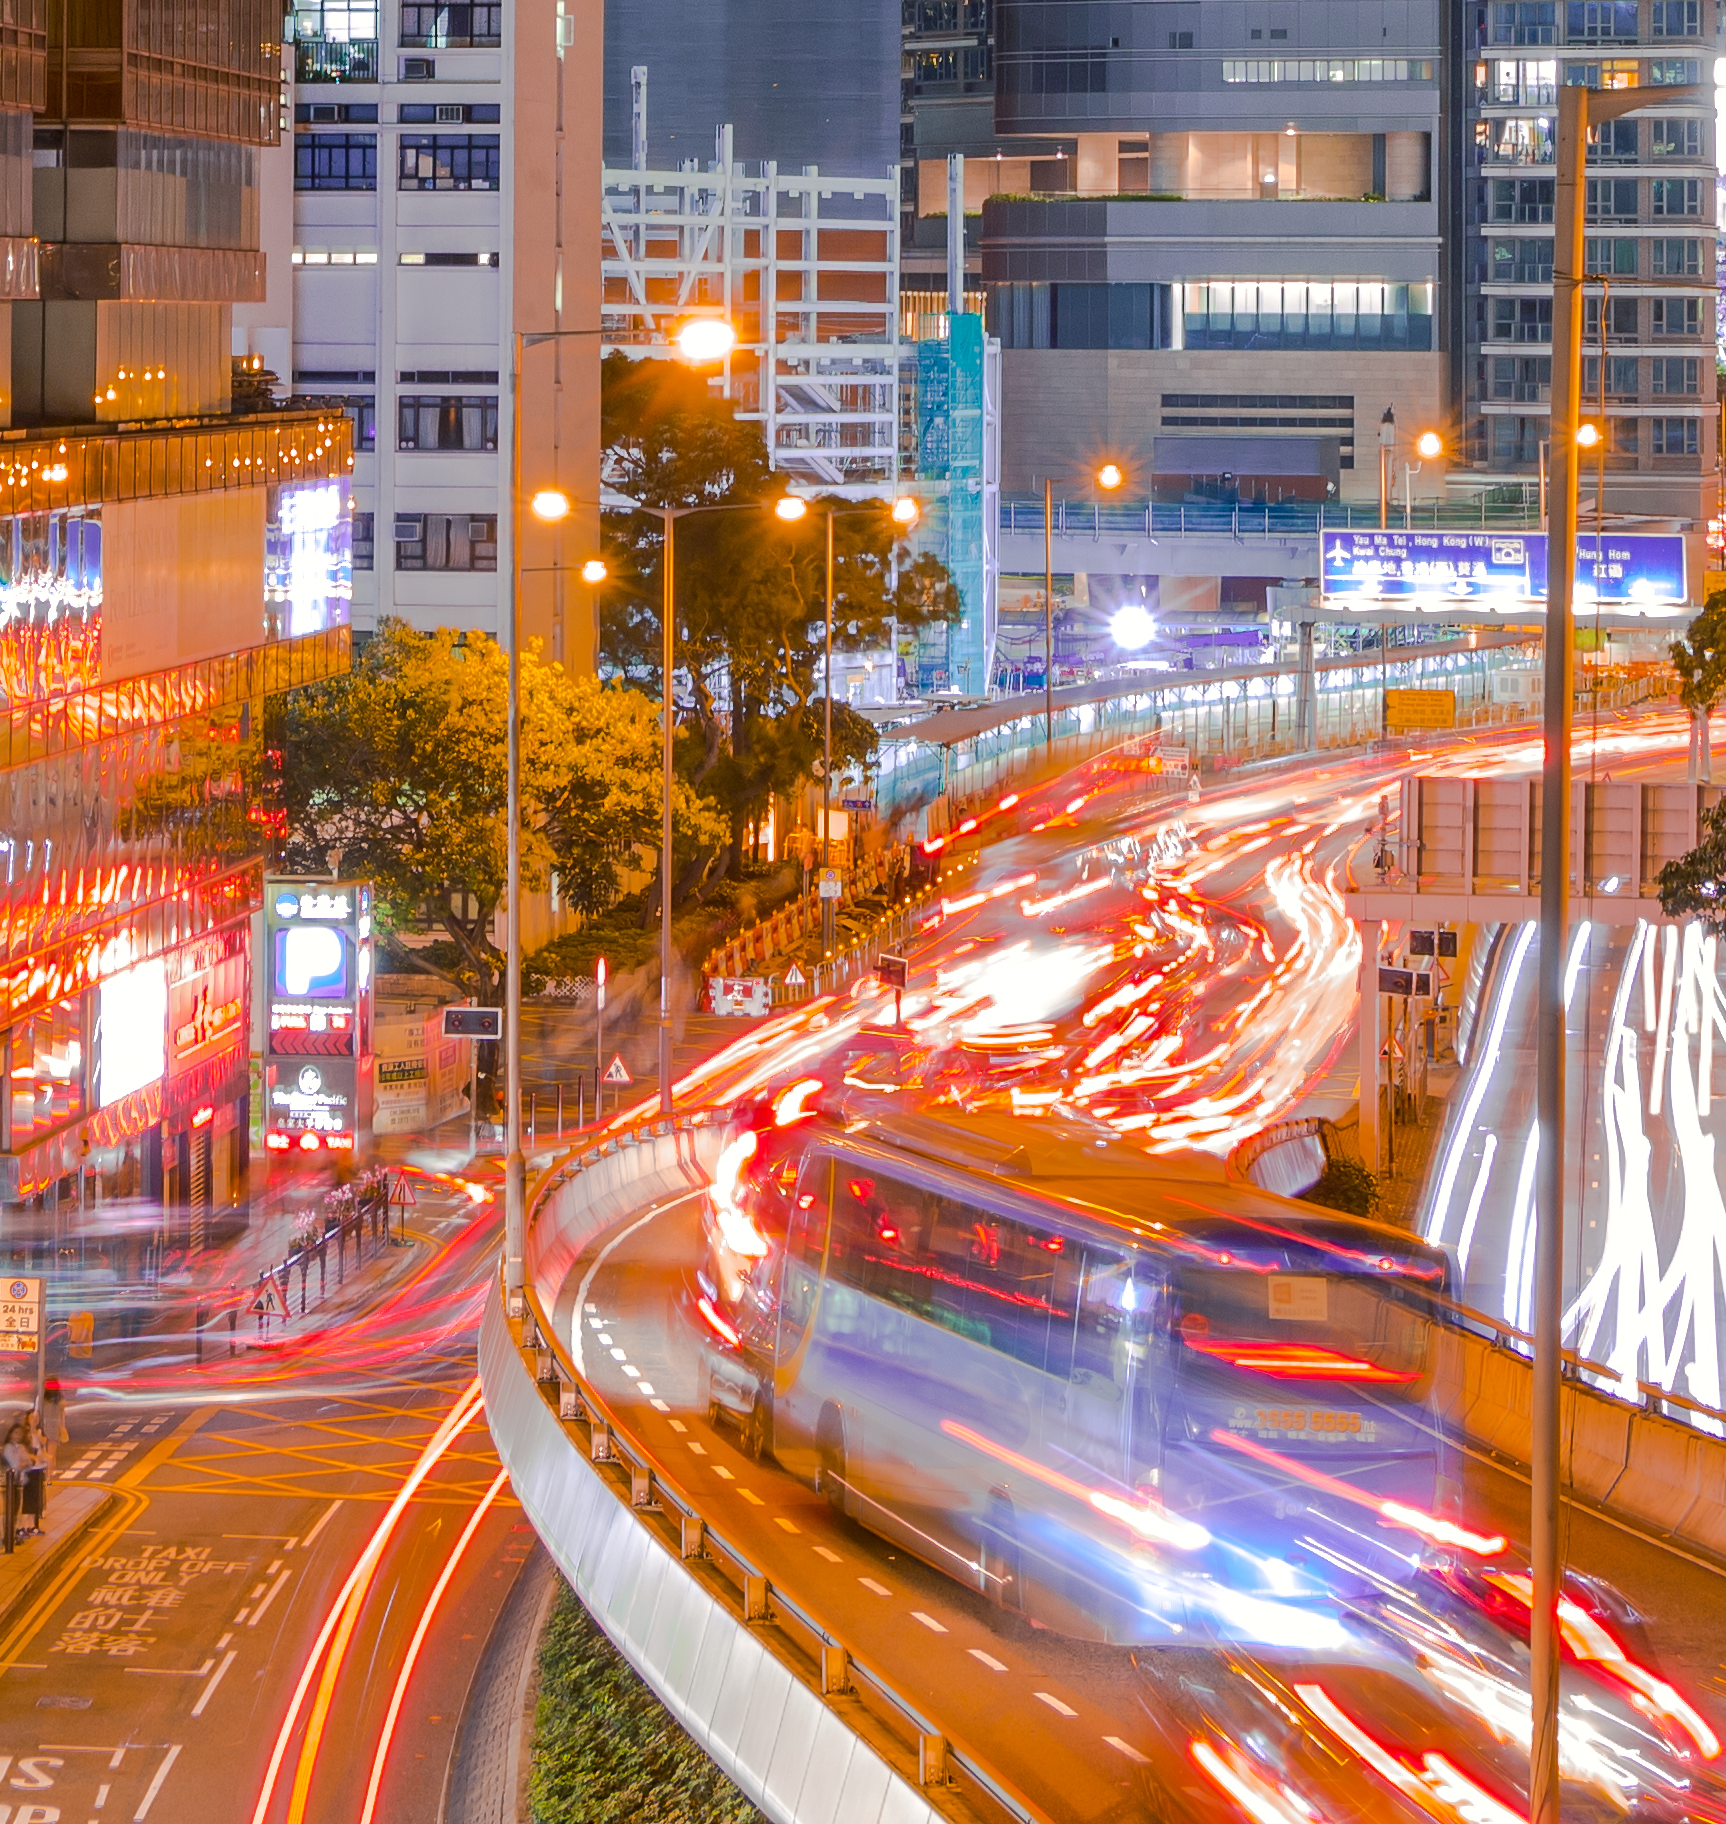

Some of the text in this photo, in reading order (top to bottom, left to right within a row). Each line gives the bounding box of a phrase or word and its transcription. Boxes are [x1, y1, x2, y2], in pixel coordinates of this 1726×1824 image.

[1353, 535, 1370, 545] Yau
[1374, 535, 1387, 545] Ma
[1414, 535, 1439, 548] Hong
[1353, 546, 1407, 558] Kwai Chung
[1579, 549, 1631, 562] Hung Hom
[2, 1304, 34, 1314] 24 hrs
[5, 1316, 30, 1328] 全日
[1310, 1410, 1362, 1433] 5555
[141, 1545, 213, 1560] TAXI
[78, 1556, 253, 1575] DROP OFF
[108, 1570, 203, 1587] ONLY
[67, 1607, 169, 1631] 的士
[48, 1631, 157, 1656] 落客
